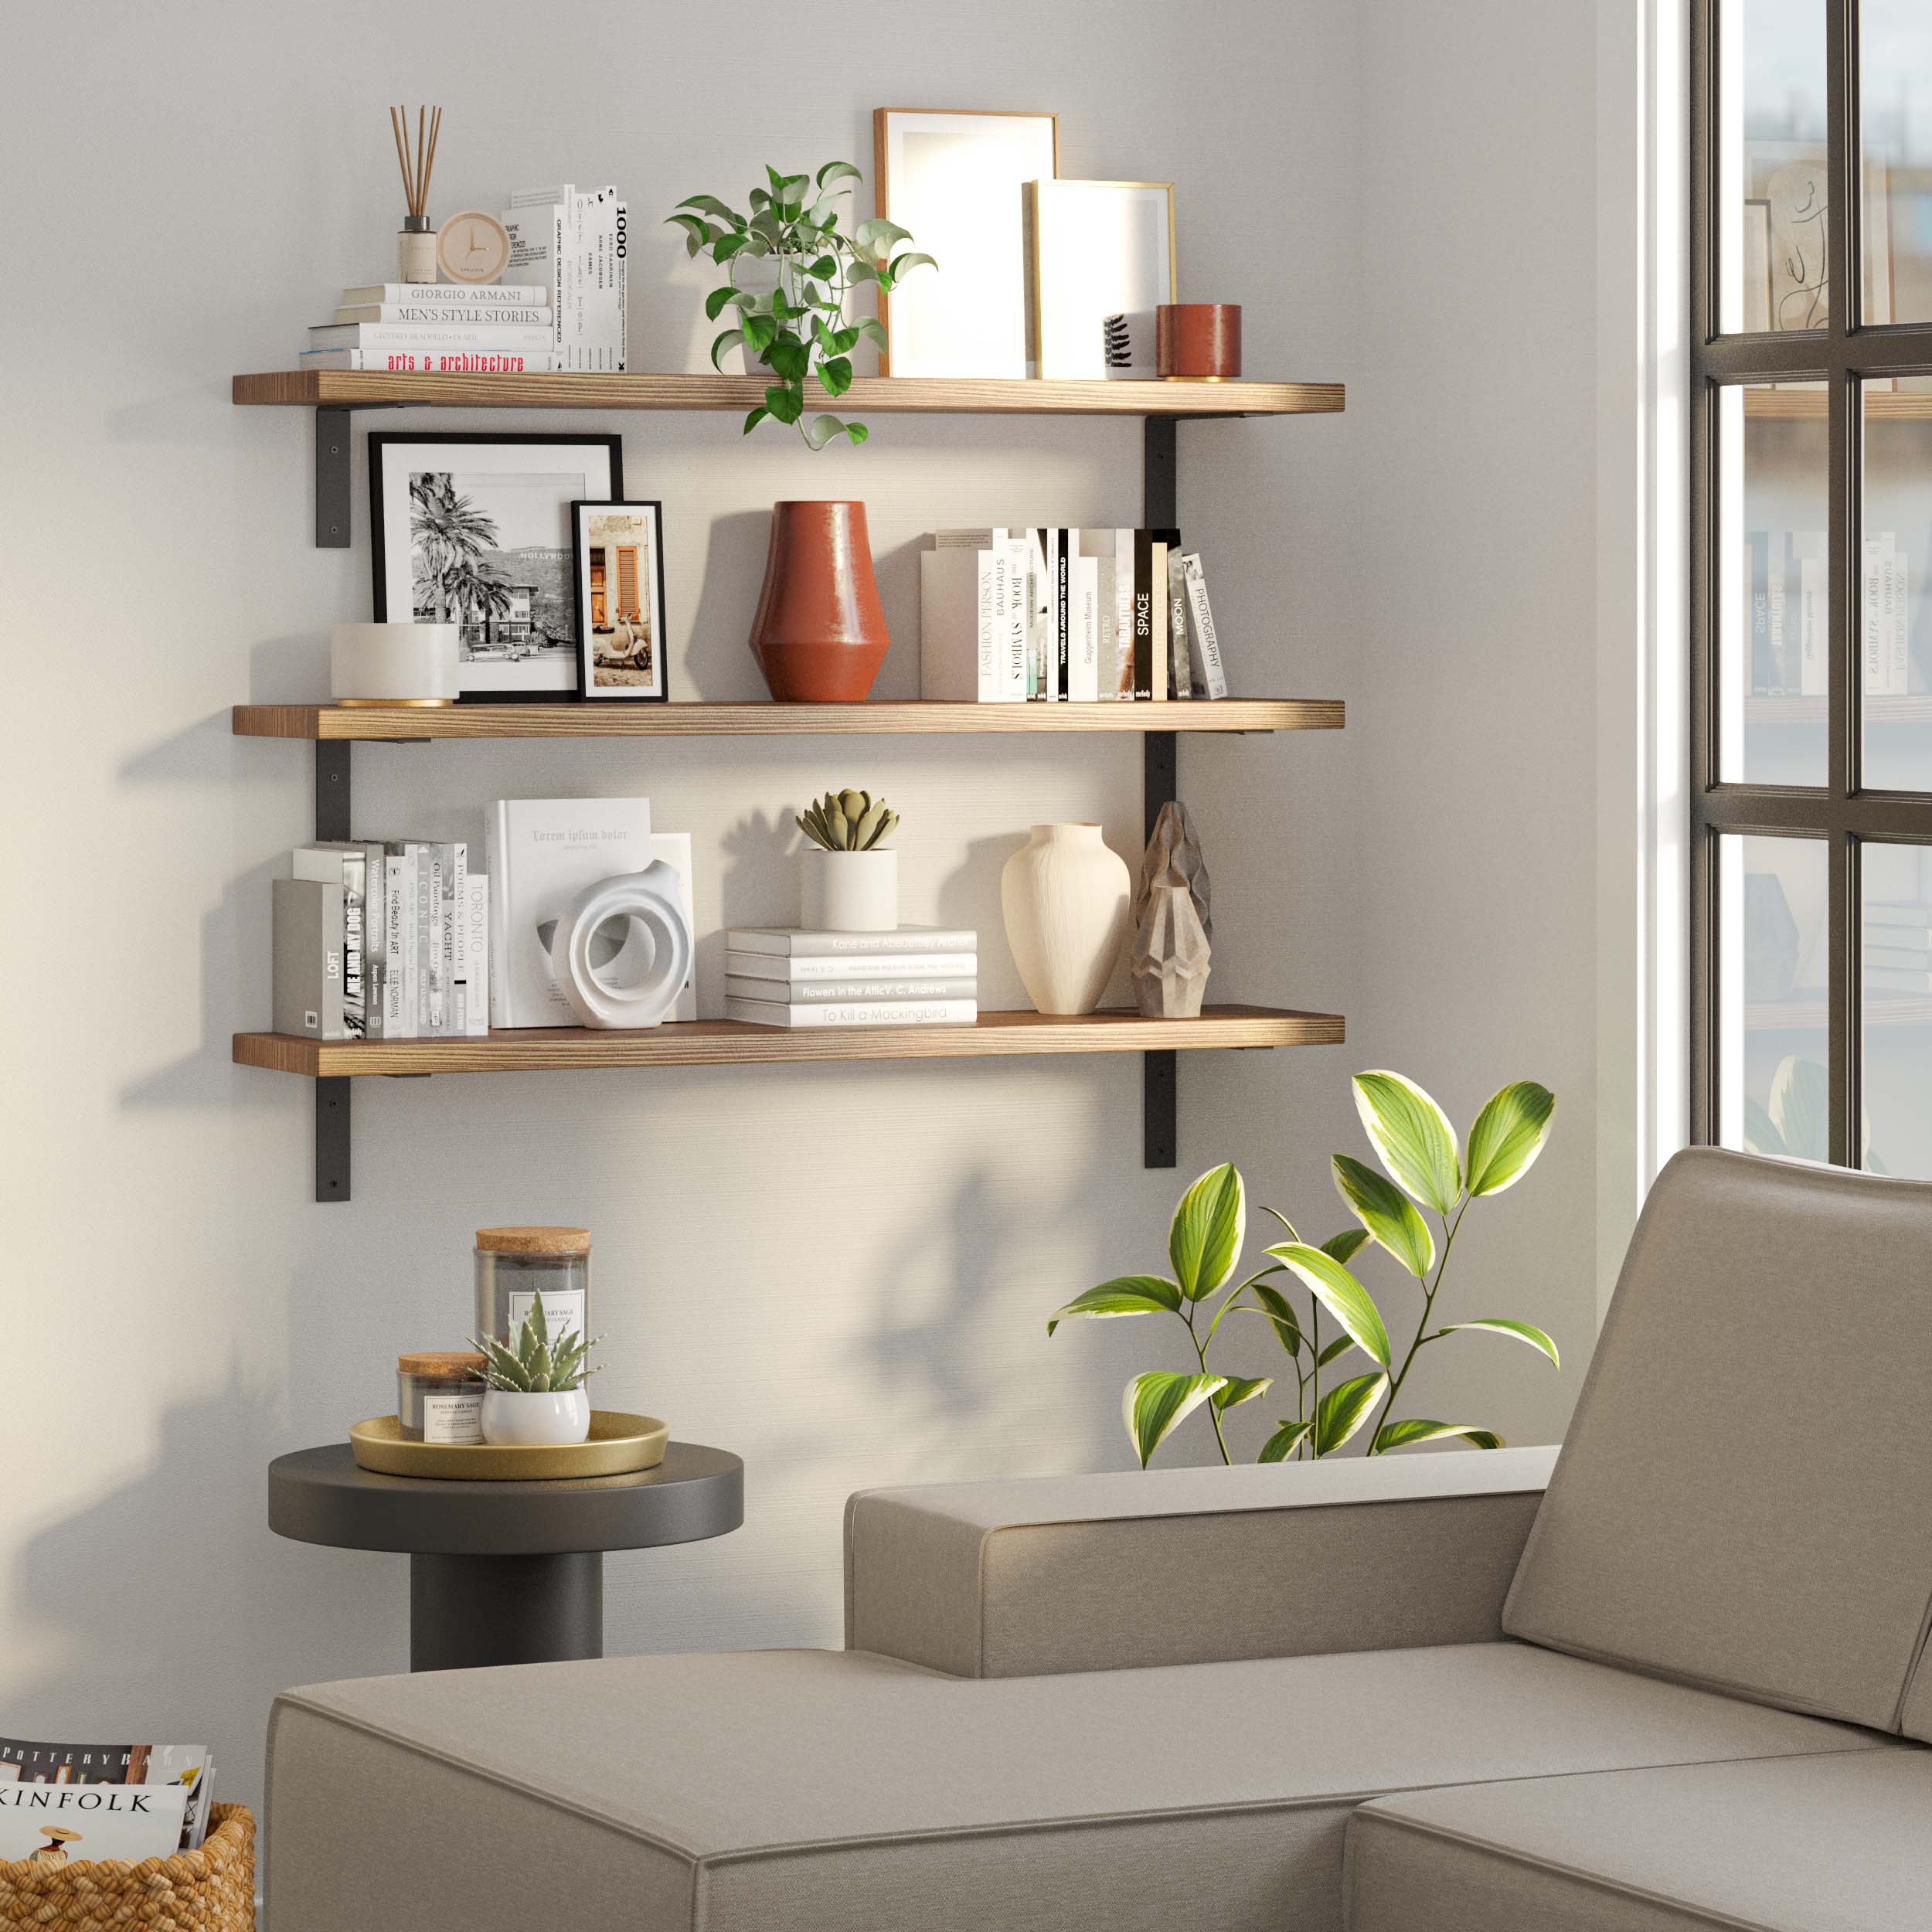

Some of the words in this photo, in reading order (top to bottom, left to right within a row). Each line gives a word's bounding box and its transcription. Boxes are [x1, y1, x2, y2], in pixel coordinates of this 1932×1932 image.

[617, 207, 627, 259] 1000
[411, 289, 465, 299] GIORGIO
[470, 291, 521, 301] ARMANI
[399, 308, 438, 321] MEN'S
[442, 309, 481, 321] STYLE
[485, 310, 539, 322] STORIES
[388, 354, 414, 370] arts
[424, 356, 433, 370] &
[440, 352, 524, 372] architecture
[981, 572, 992, 620] PERSON
[996, 559, 1005, 616] BAUHAUS
[1012, 577, 1022, 609] BOOK
[1084, 591, 1093, 619] Museum
[1138, 593, 1148, 635] SPACE
[1173, 598, 1184, 635] MOON
[1195, 588, 1219, 668] PHOTOGRAPHY
[981, 622, 992, 676] FASHION
[1012, 622, 1022, 680] SYMBOLS
[1084, 621, 1093, 664] Guggenheim
[532, 830, 565, 841] Lorem
[569, 829, 598, 842] ipsum
[600, 829, 629, 841] dolor
[370, 859, 380, 910] Watercolor
[389, 906, 400, 930] Beauty
[419, 871, 427, 944] ICONIC
[430, 881, 440, 927] Paintings
[457, 911, 464, 920] &
[346, 907, 361, 931] DOG
[471, 884, 483, 953] TORONTO
[346, 933, 361, 951] MY
[370, 913, 380, 953] Portraits
[389, 941, 398, 954] ART
[327, 951, 339, 979] LOFT
[346, 951, 361, 975] AND
[371, 964, 379, 981] Aspen
[346, 976, 361, 994] ME
[389, 970, 398, 985] ELLE
[802, 987, 835, 998] Flowers
[848, 985, 862, 996] the
[896, 984, 906, 995] C.
[908, 982, 947, 995] Andrews
[389, 986, 398, 1018] NORMAN
[822, 1009, 836, 1021] To
[840, 1008, 855, 1021] Kill
[859, 1011, 867, 1021] a
[871, 1006, 947, 1022] Mockingbird
